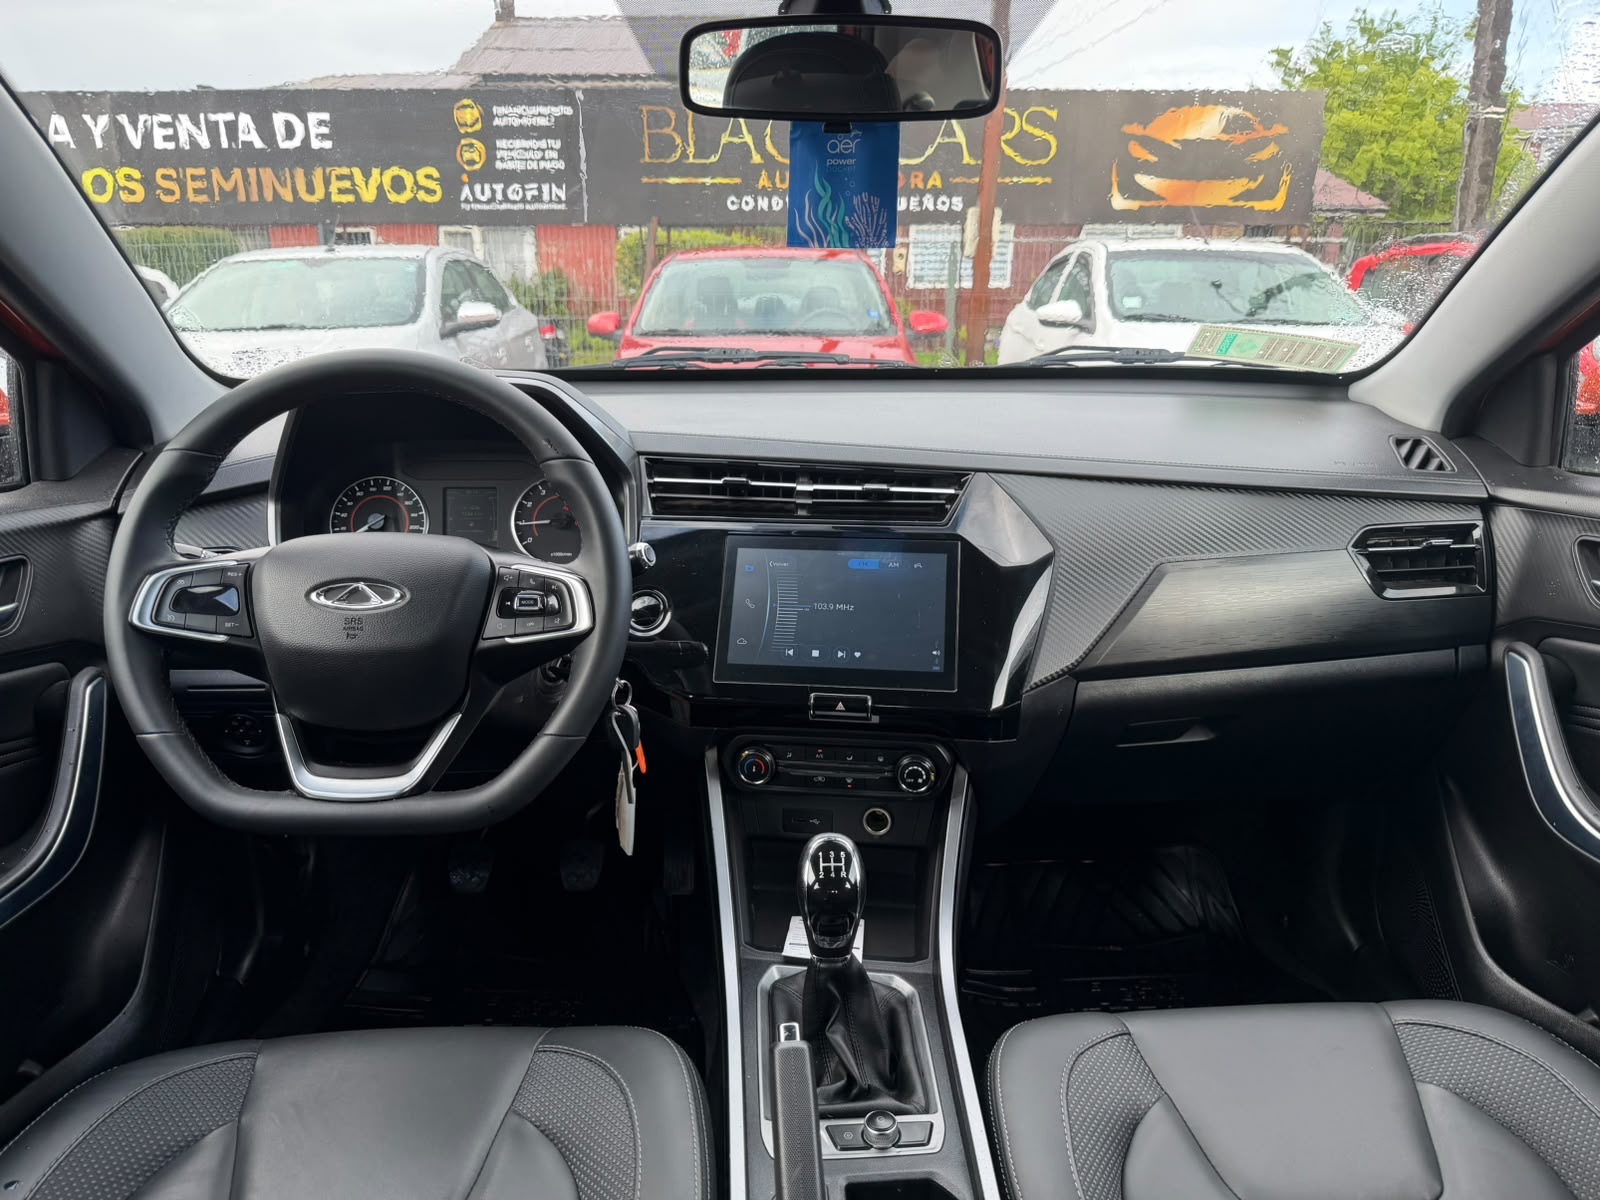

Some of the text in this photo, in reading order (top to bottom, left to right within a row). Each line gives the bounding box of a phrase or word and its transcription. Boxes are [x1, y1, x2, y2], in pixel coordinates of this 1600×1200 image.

[82, 113, 109, 149] Y
[115, 112, 268, 150] VENTA
[271, 111, 333, 150] DE
[826, 138, 861, 154] aer
[826, 158, 857, 168] power
[155, 166, 443, 204] SEMINUEVOS
[460, 182, 566, 202] AUTOFIN
[813, 602, 834, 610] 103.9
[836, 603, 855, 611] MHz
[343, 617, 364, 625] SRS
[829, 850, 835, 858] 3
[818, 871, 825, 879] 2
